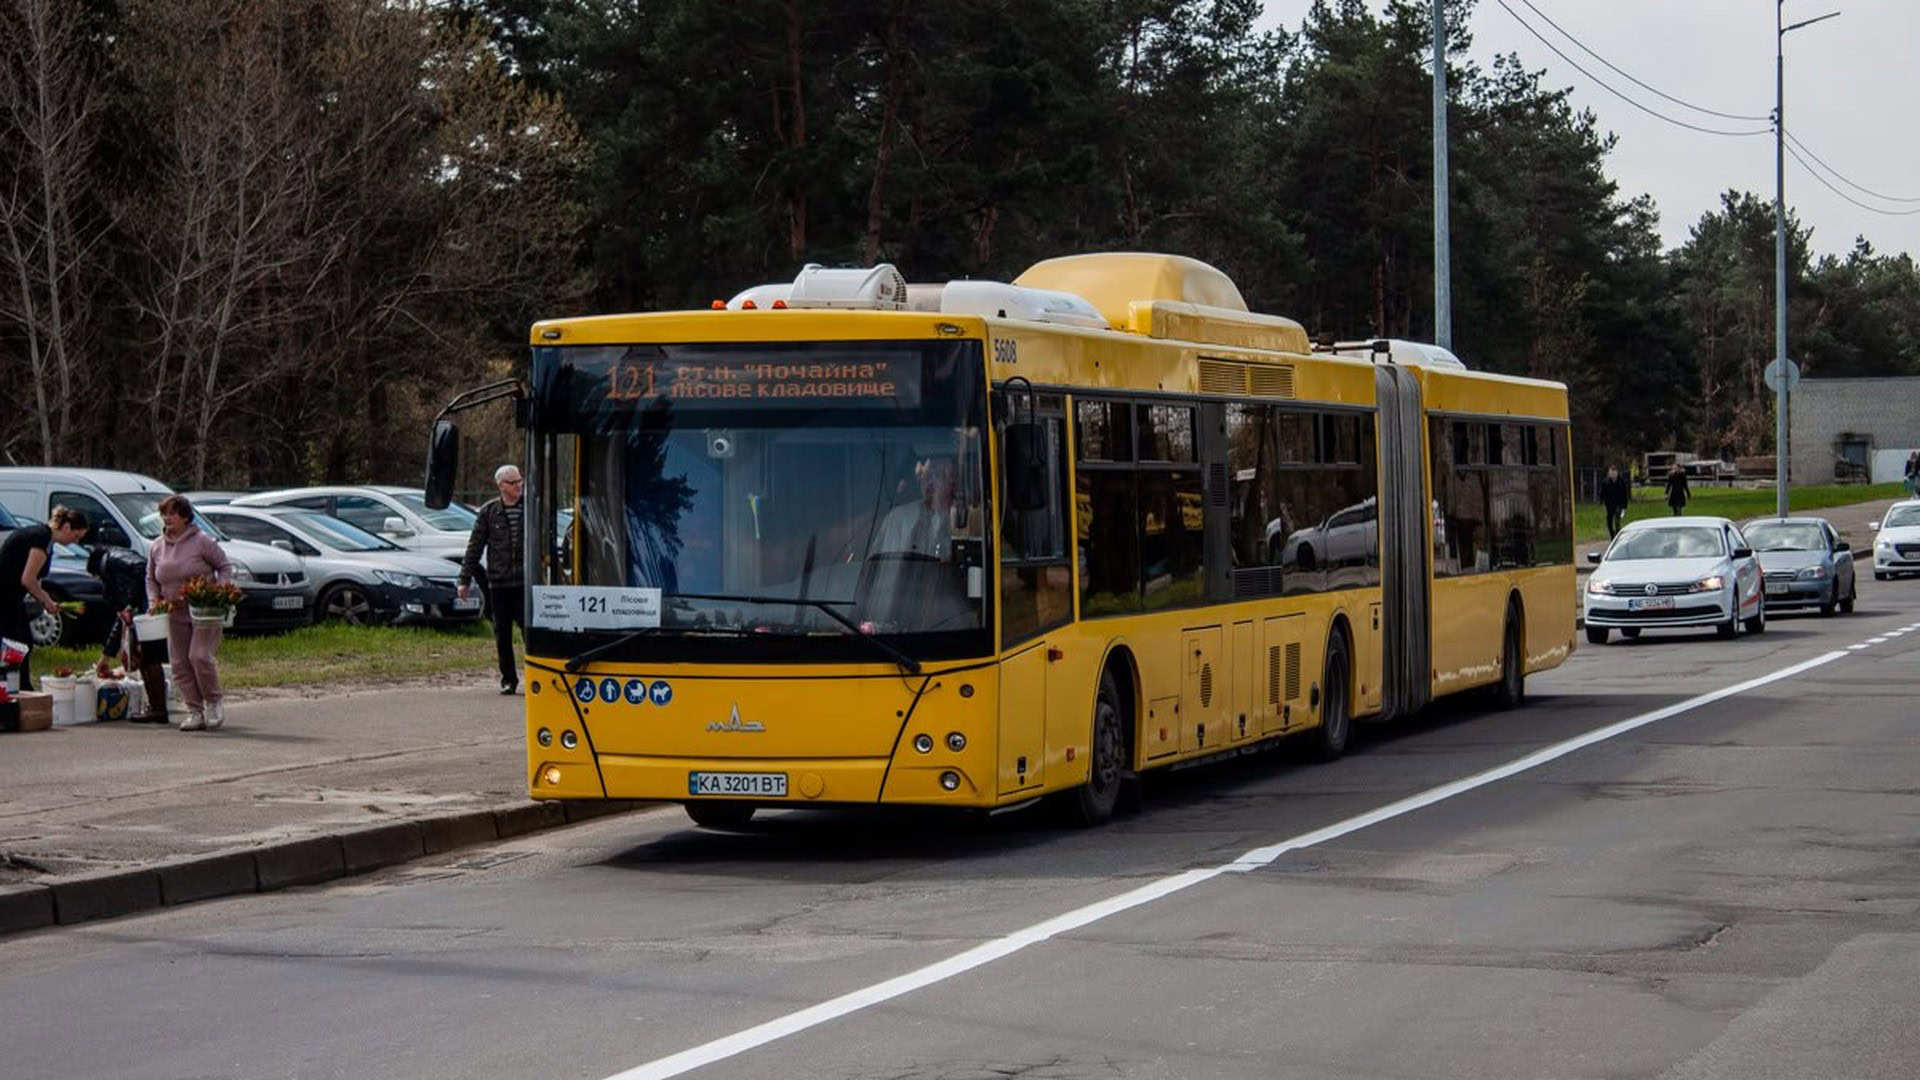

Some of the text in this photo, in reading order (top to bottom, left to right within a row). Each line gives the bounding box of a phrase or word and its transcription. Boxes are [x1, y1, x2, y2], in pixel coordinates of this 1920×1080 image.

[994, 338, 1017, 364] 5608
[605, 363, 657, 399] 121
[757, 381, 896, 398] кладовище
[578, 596, 607, 613] 121
[699, 776, 784, 792] KA 3201 BT
